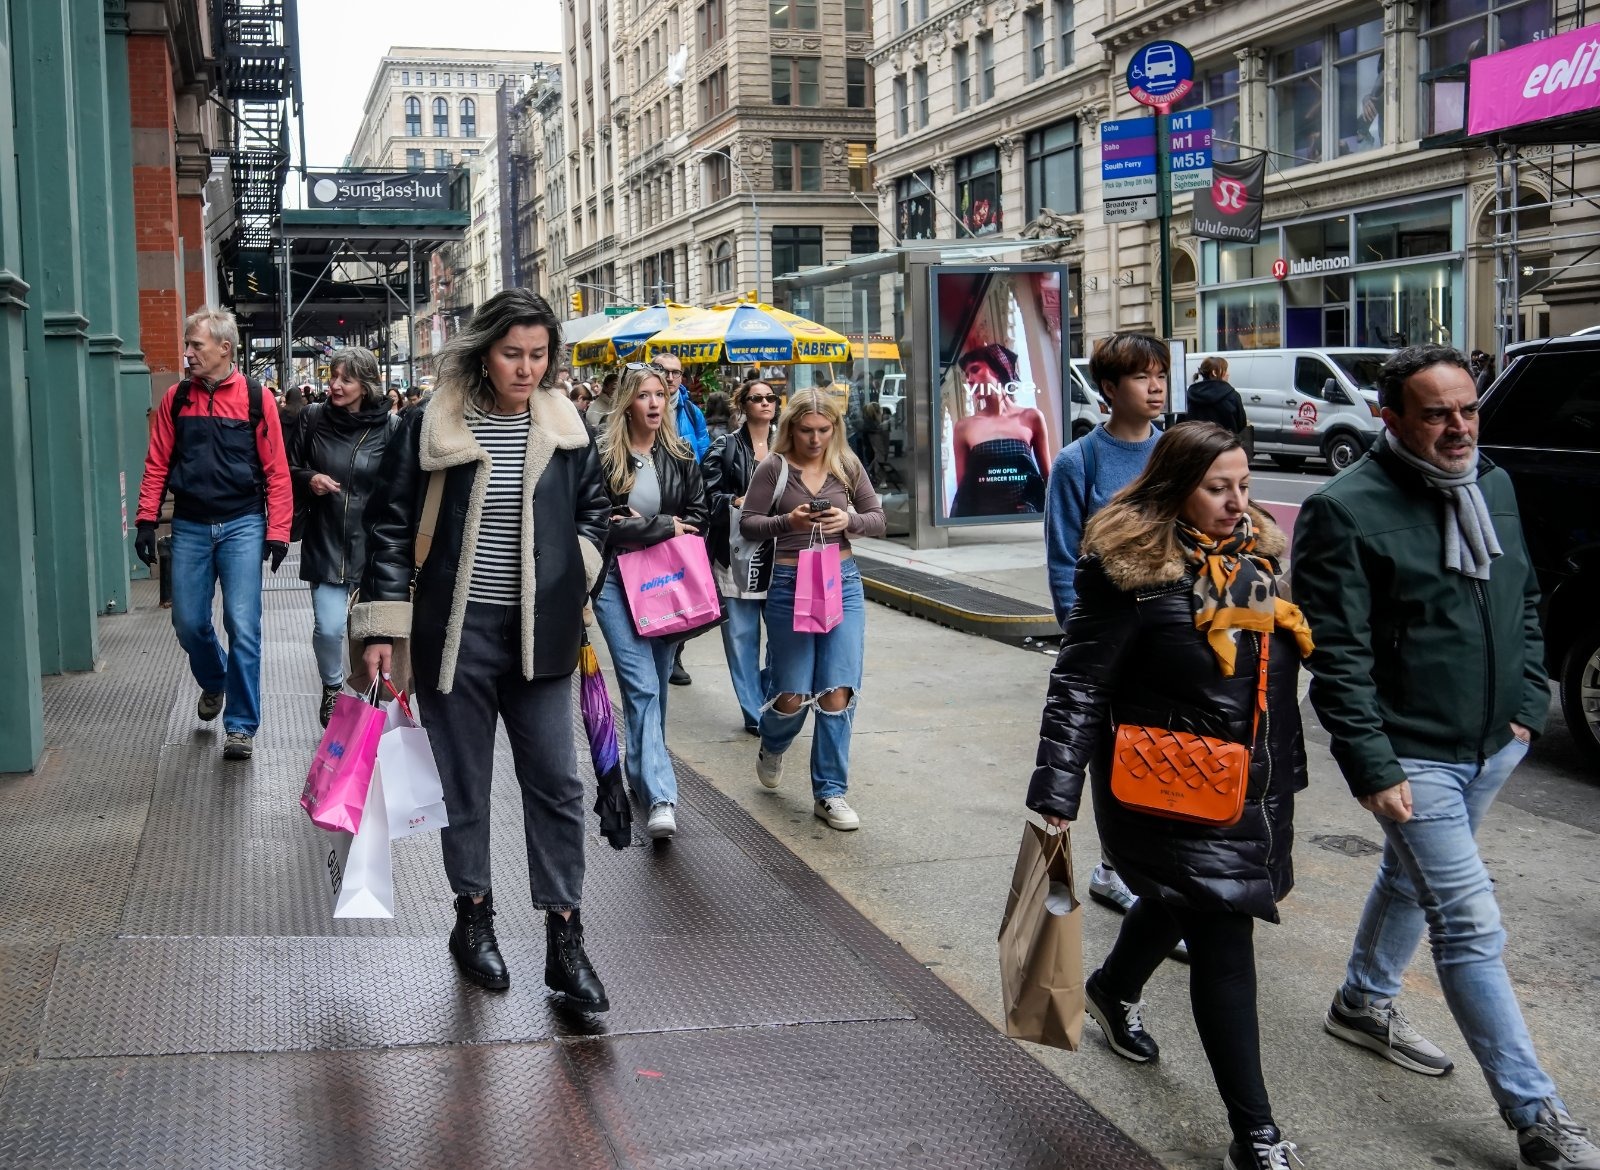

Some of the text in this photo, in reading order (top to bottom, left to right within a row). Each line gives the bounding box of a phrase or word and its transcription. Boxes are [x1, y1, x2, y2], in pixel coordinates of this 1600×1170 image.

[1136, 90, 1147, 101] NO
[1148, 84, 1189, 104] STANDING
[1172, 114, 1192, 130] M1
[1104, 143, 1120, 151] Soho
[1172, 133, 1193, 150] M1
[1104, 160, 1142, 171] South Ferry
[1172, 151, 1206, 169] M55
[1174, 172, 1199, 181] Topview
[1105, 181, 1115, 189] Pick
[1124, 180, 1135, 188] Drop
[1143, 177, 1153, 185] Only
[1174, 179, 1211, 190] Sightseeing
[340, 179, 443, 202] sunglass hut
[1105, 199, 1138, 209] Broadway
[1106, 207, 1127, 216] Spring
[1194, 217, 1255, 239] lululemon
[1290, 255, 1350, 275] lululemon
[651, 342, 718, 358] SABRETT
[797, 341, 846, 357] SABRETT
[1008, 474, 1028, 482] STREET
[1160, 788, 1185, 799] PRADA
[1249, 1128, 1274, 1137] PRADA
